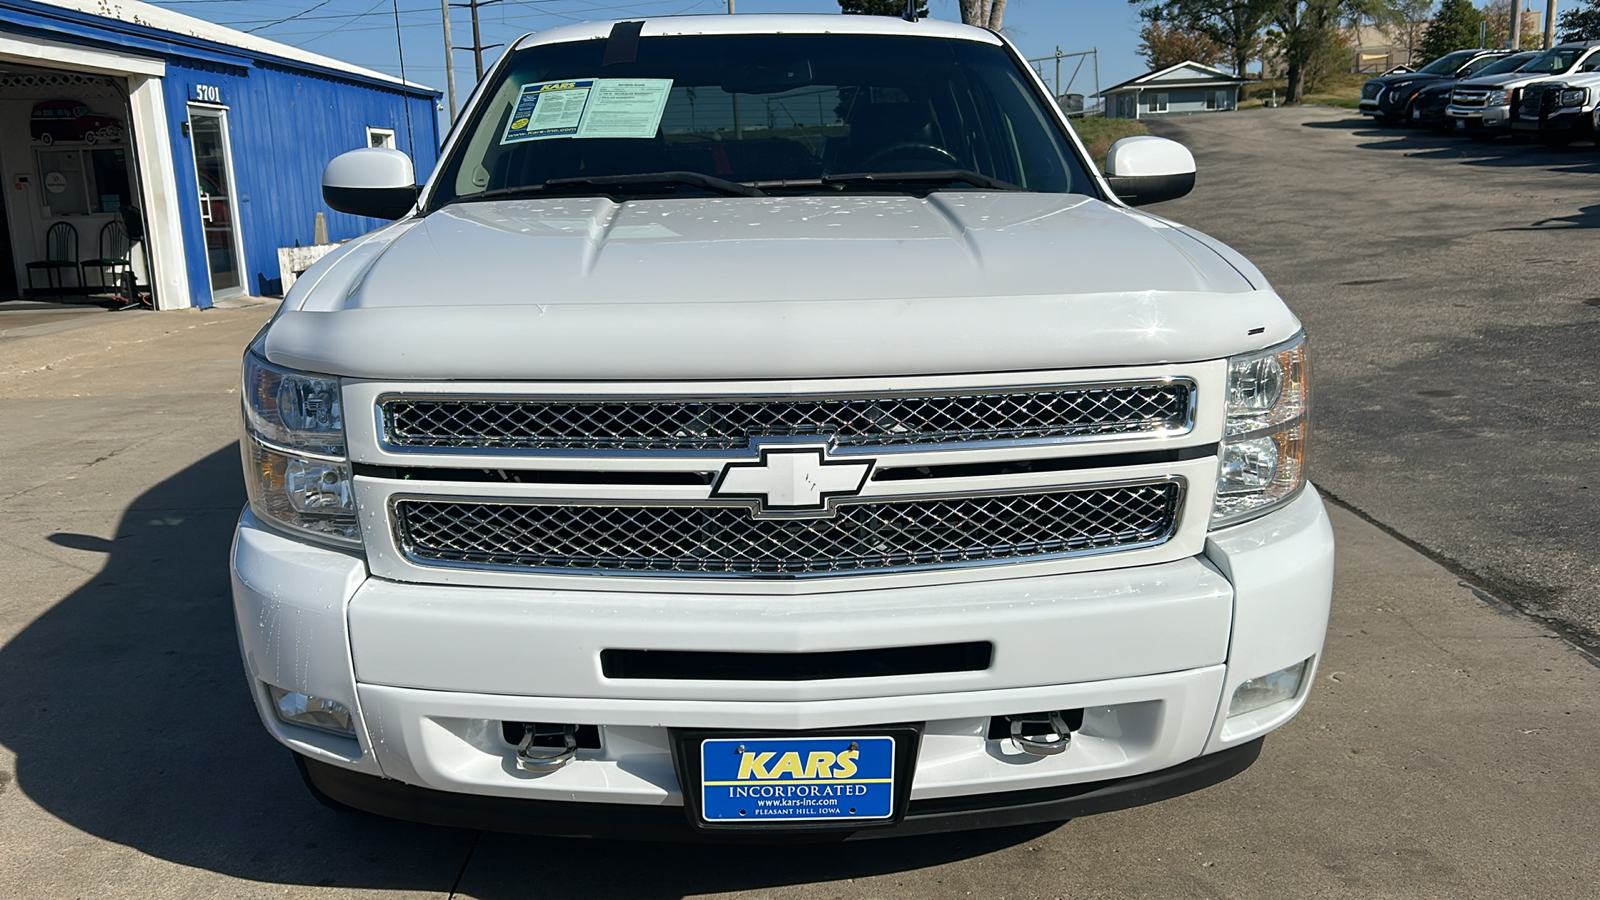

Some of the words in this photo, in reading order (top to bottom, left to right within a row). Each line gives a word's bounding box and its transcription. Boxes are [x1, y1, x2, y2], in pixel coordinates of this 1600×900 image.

[197, 84, 221, 102] 5701
[541, 82, 576, 91] KARS
[737, 750, 860, 780] KARS
[729, 785, 867, 798] INCORPORATED
[757, 798, 838, 807] www.kars-inc.com
